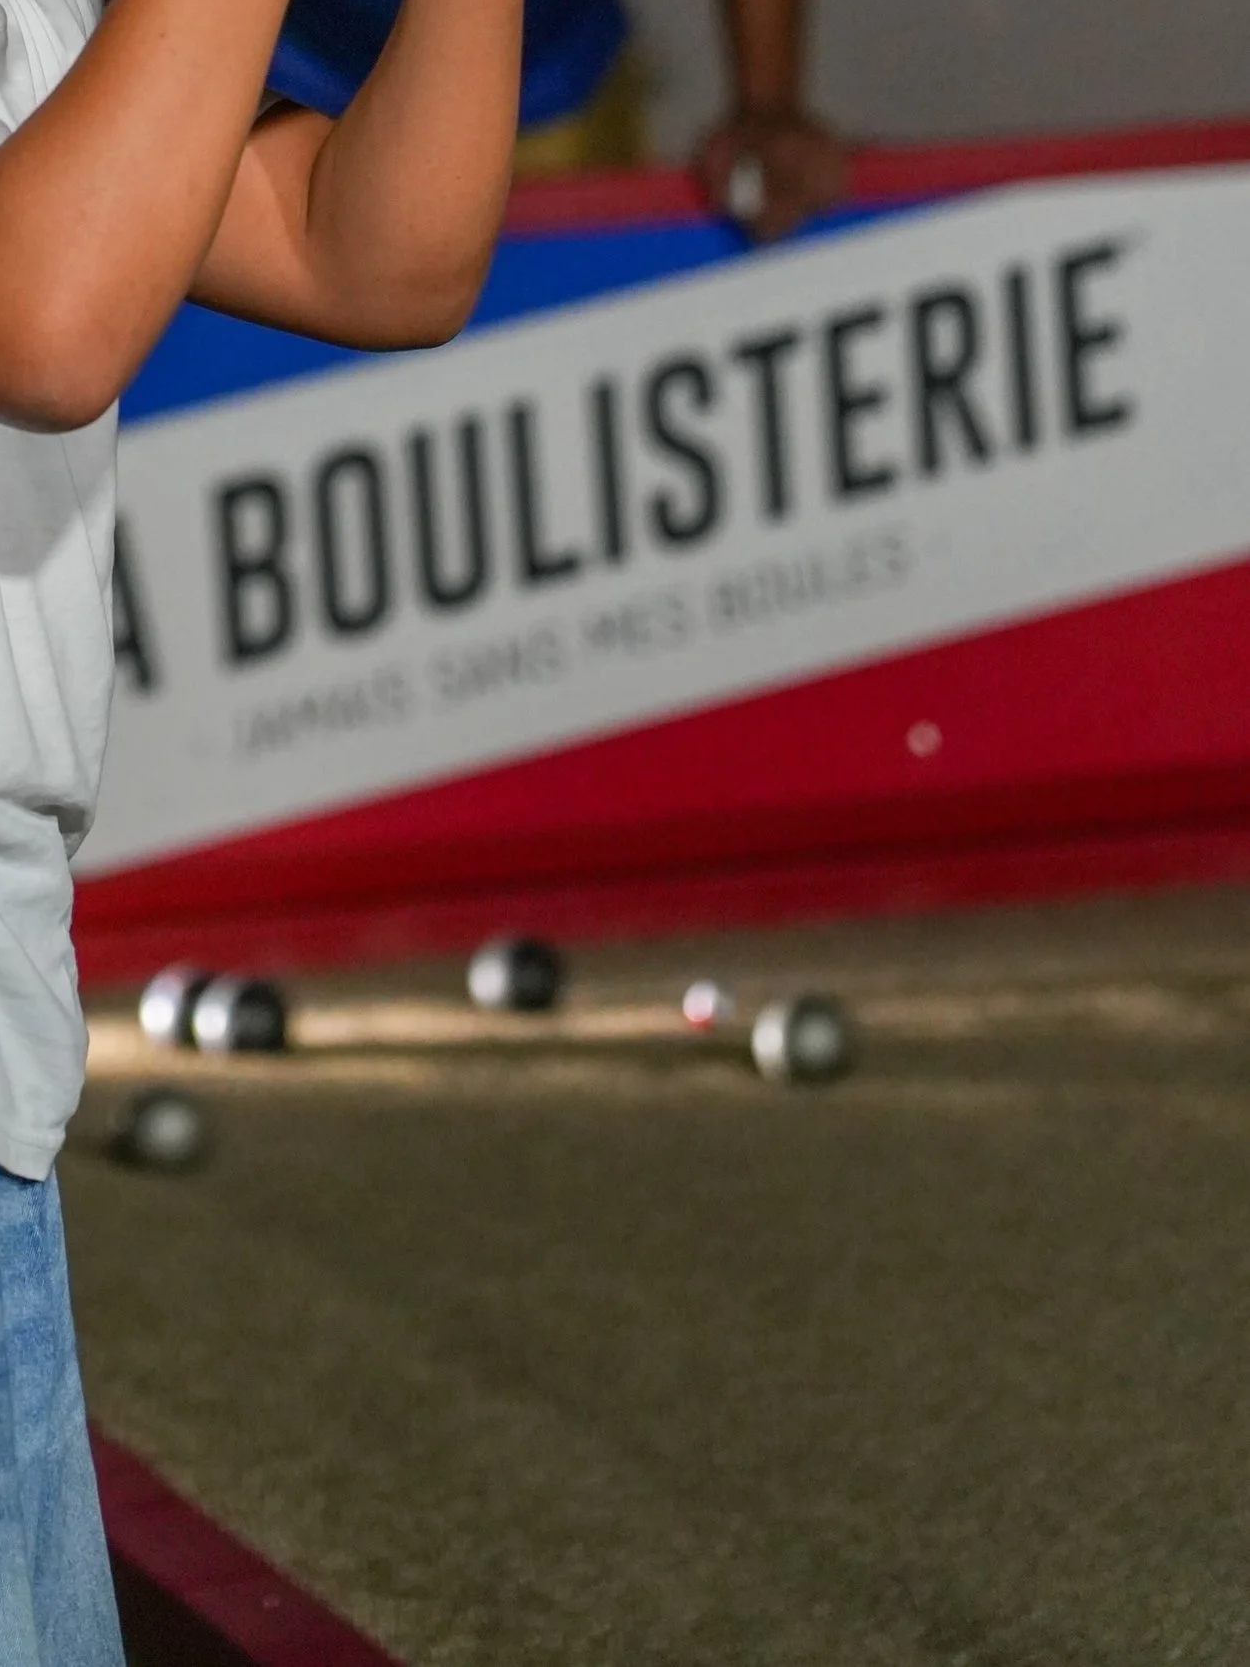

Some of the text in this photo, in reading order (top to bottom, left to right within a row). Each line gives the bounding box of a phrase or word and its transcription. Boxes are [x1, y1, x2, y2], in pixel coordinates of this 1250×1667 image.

[213, 236, 1138, 672] BOULISTERIE
[235, 528, 910, 755] JAMAIS SANS MES BOULES
